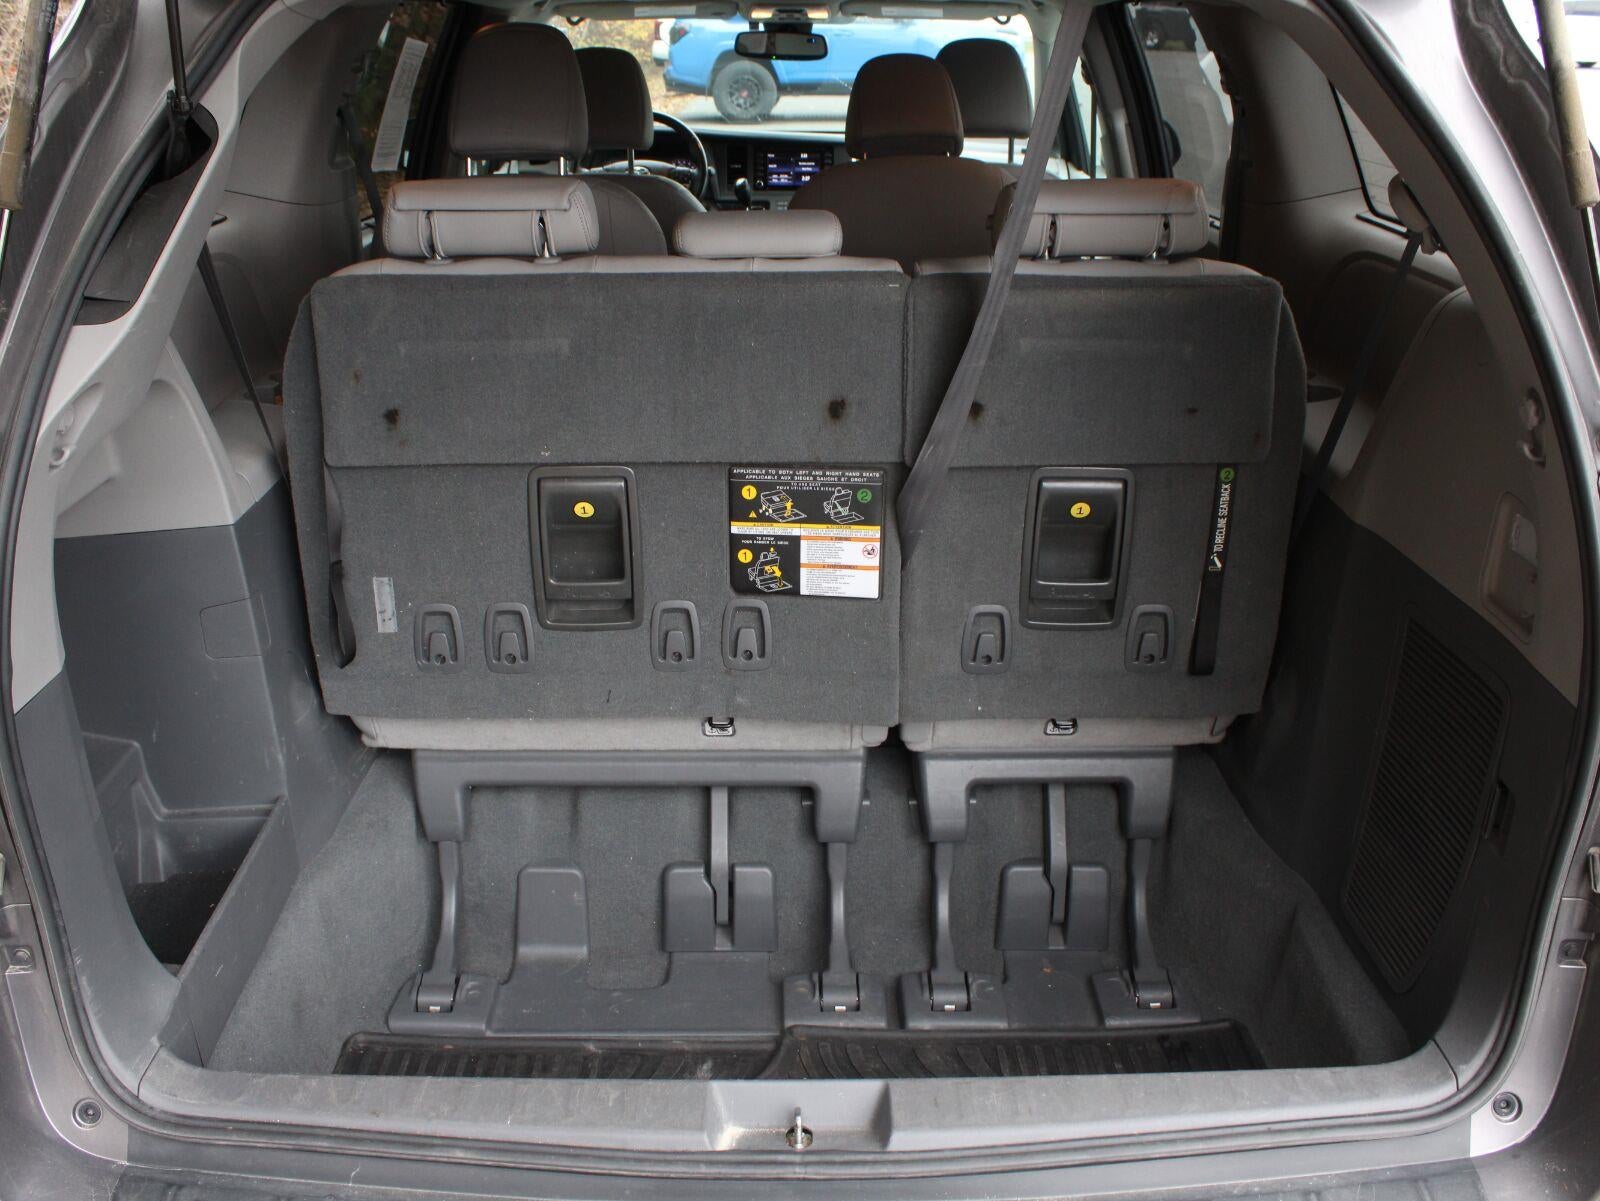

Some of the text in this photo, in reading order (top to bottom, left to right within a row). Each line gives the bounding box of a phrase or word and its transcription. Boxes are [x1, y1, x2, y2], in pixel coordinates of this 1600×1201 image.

[1213, 483, 1232, 552] TO RECLINE SEATBACK
